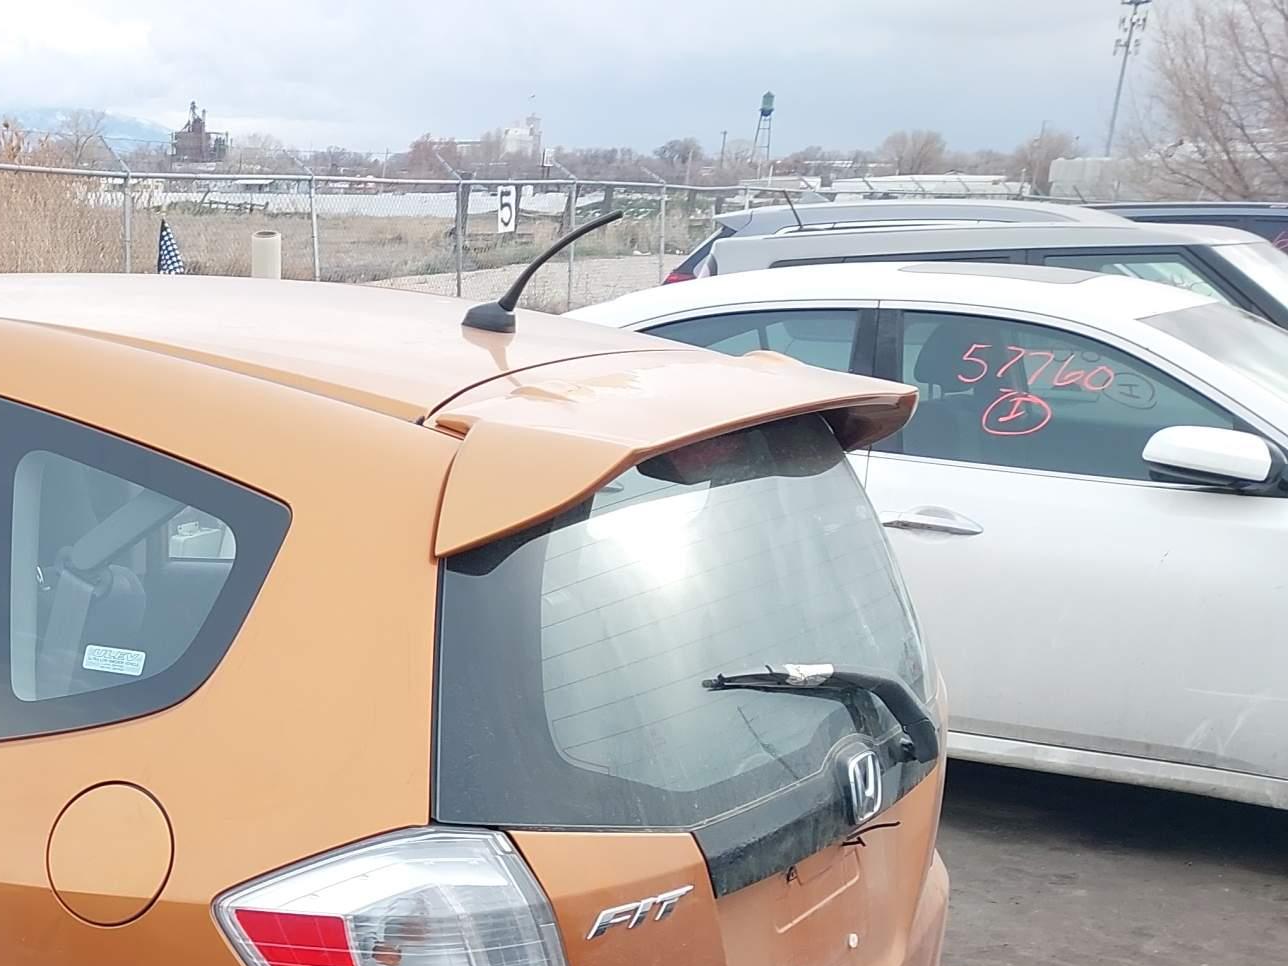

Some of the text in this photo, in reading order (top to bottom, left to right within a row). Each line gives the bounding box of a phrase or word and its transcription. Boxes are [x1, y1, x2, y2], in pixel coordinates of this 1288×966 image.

[500, 190, 512, 227] 5
[957, 343, 1114, 391] 57760
[586, 884, 695, 940] FIT
